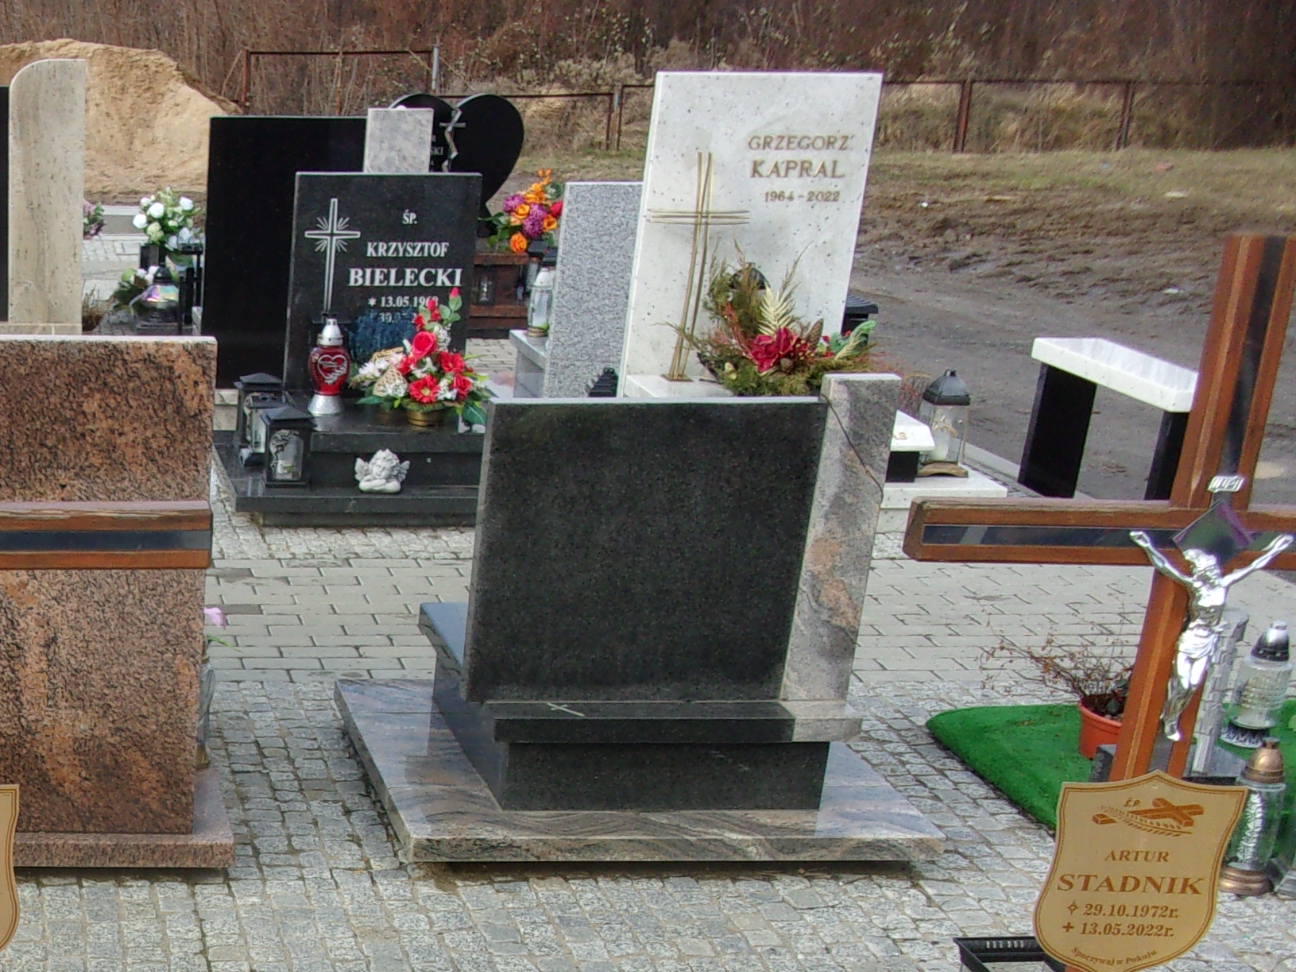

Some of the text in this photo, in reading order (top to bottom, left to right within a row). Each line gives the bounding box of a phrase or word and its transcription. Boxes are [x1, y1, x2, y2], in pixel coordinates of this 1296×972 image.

[747, 134, 850, 151] GRZEGORZ
[749, 159, 846, 178] KAPRAL
[366, 241, 450, 257] KRZYSZTOF
[347, 267, 464, 287] BIELECKI
[1104, 849, 1170, 863] ARTUR
[1056, 873, 1205, 896] STADNIK
[1083, 902, 1180, 919] 29.10.1972r.
[1079, 921, 1176, 938] 13.05.2022r.
